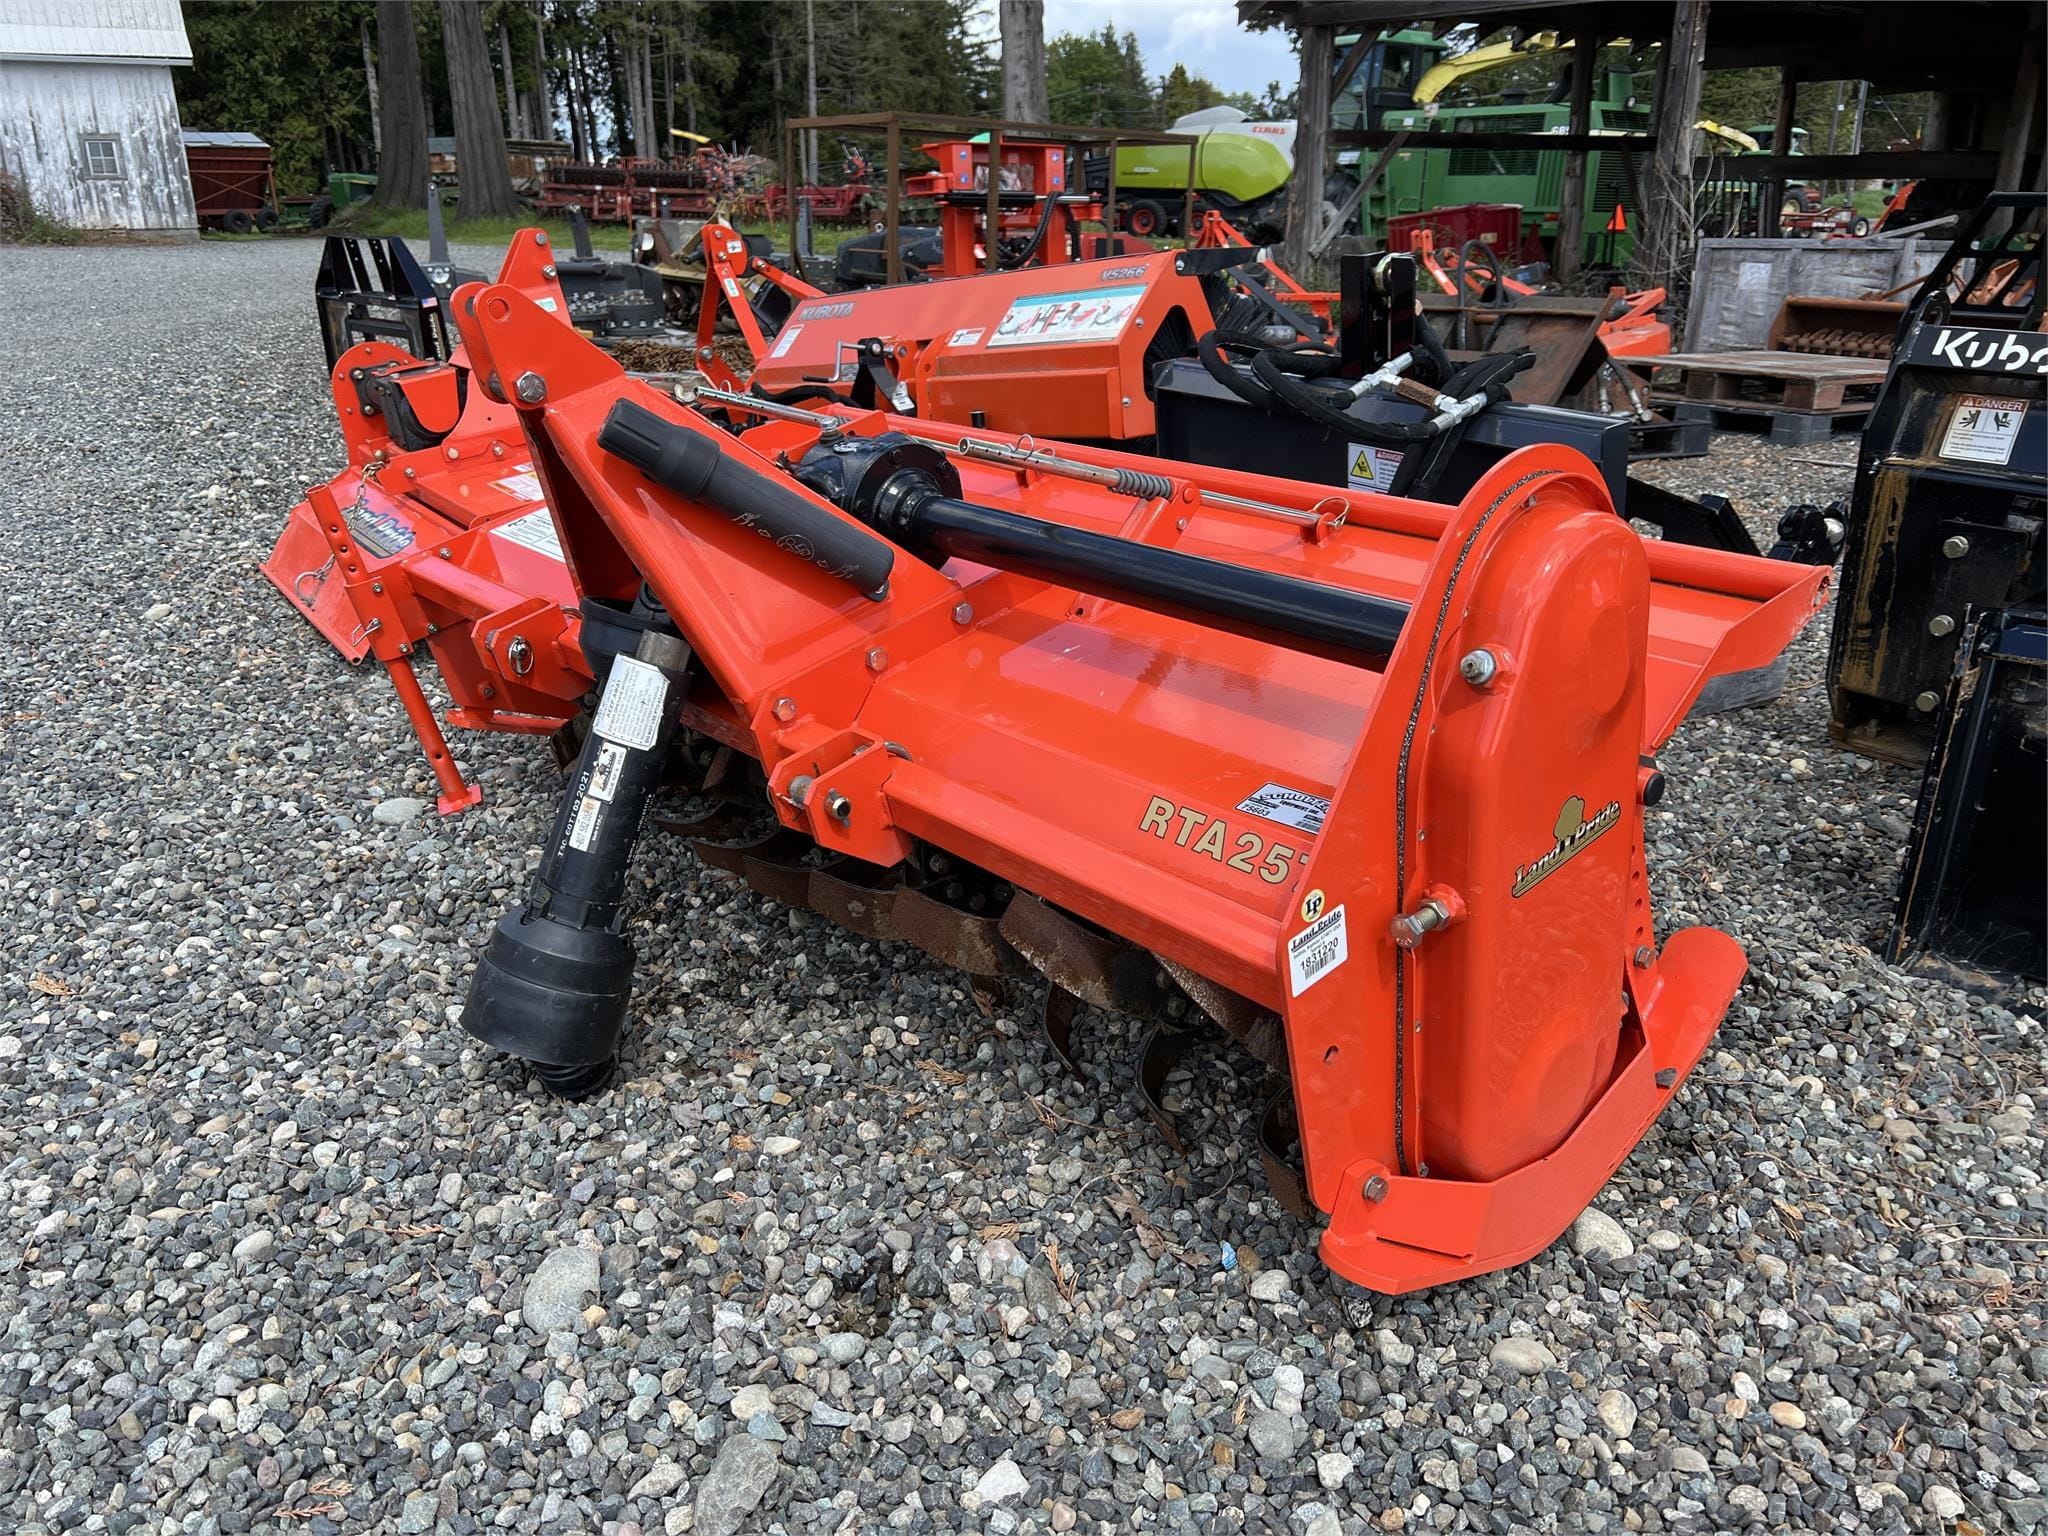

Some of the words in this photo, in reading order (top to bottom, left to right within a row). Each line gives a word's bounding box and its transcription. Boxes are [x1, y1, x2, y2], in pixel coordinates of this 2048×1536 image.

[798, 302, 855, 321] KUBOTA
[1975, 399, 2024, 411] DANGER
[577, 770, 591, 799] 2021
[1241, 804, 1270, 817] 75603
[1514, 839, 1565, 885] Land
[1573, 800, 1620, 842] Pride
[1291, 928, 1317, 951] Land
[1317, 910, 1342, 932] Pride
[1300, 937, 1339, 971] 1831220
